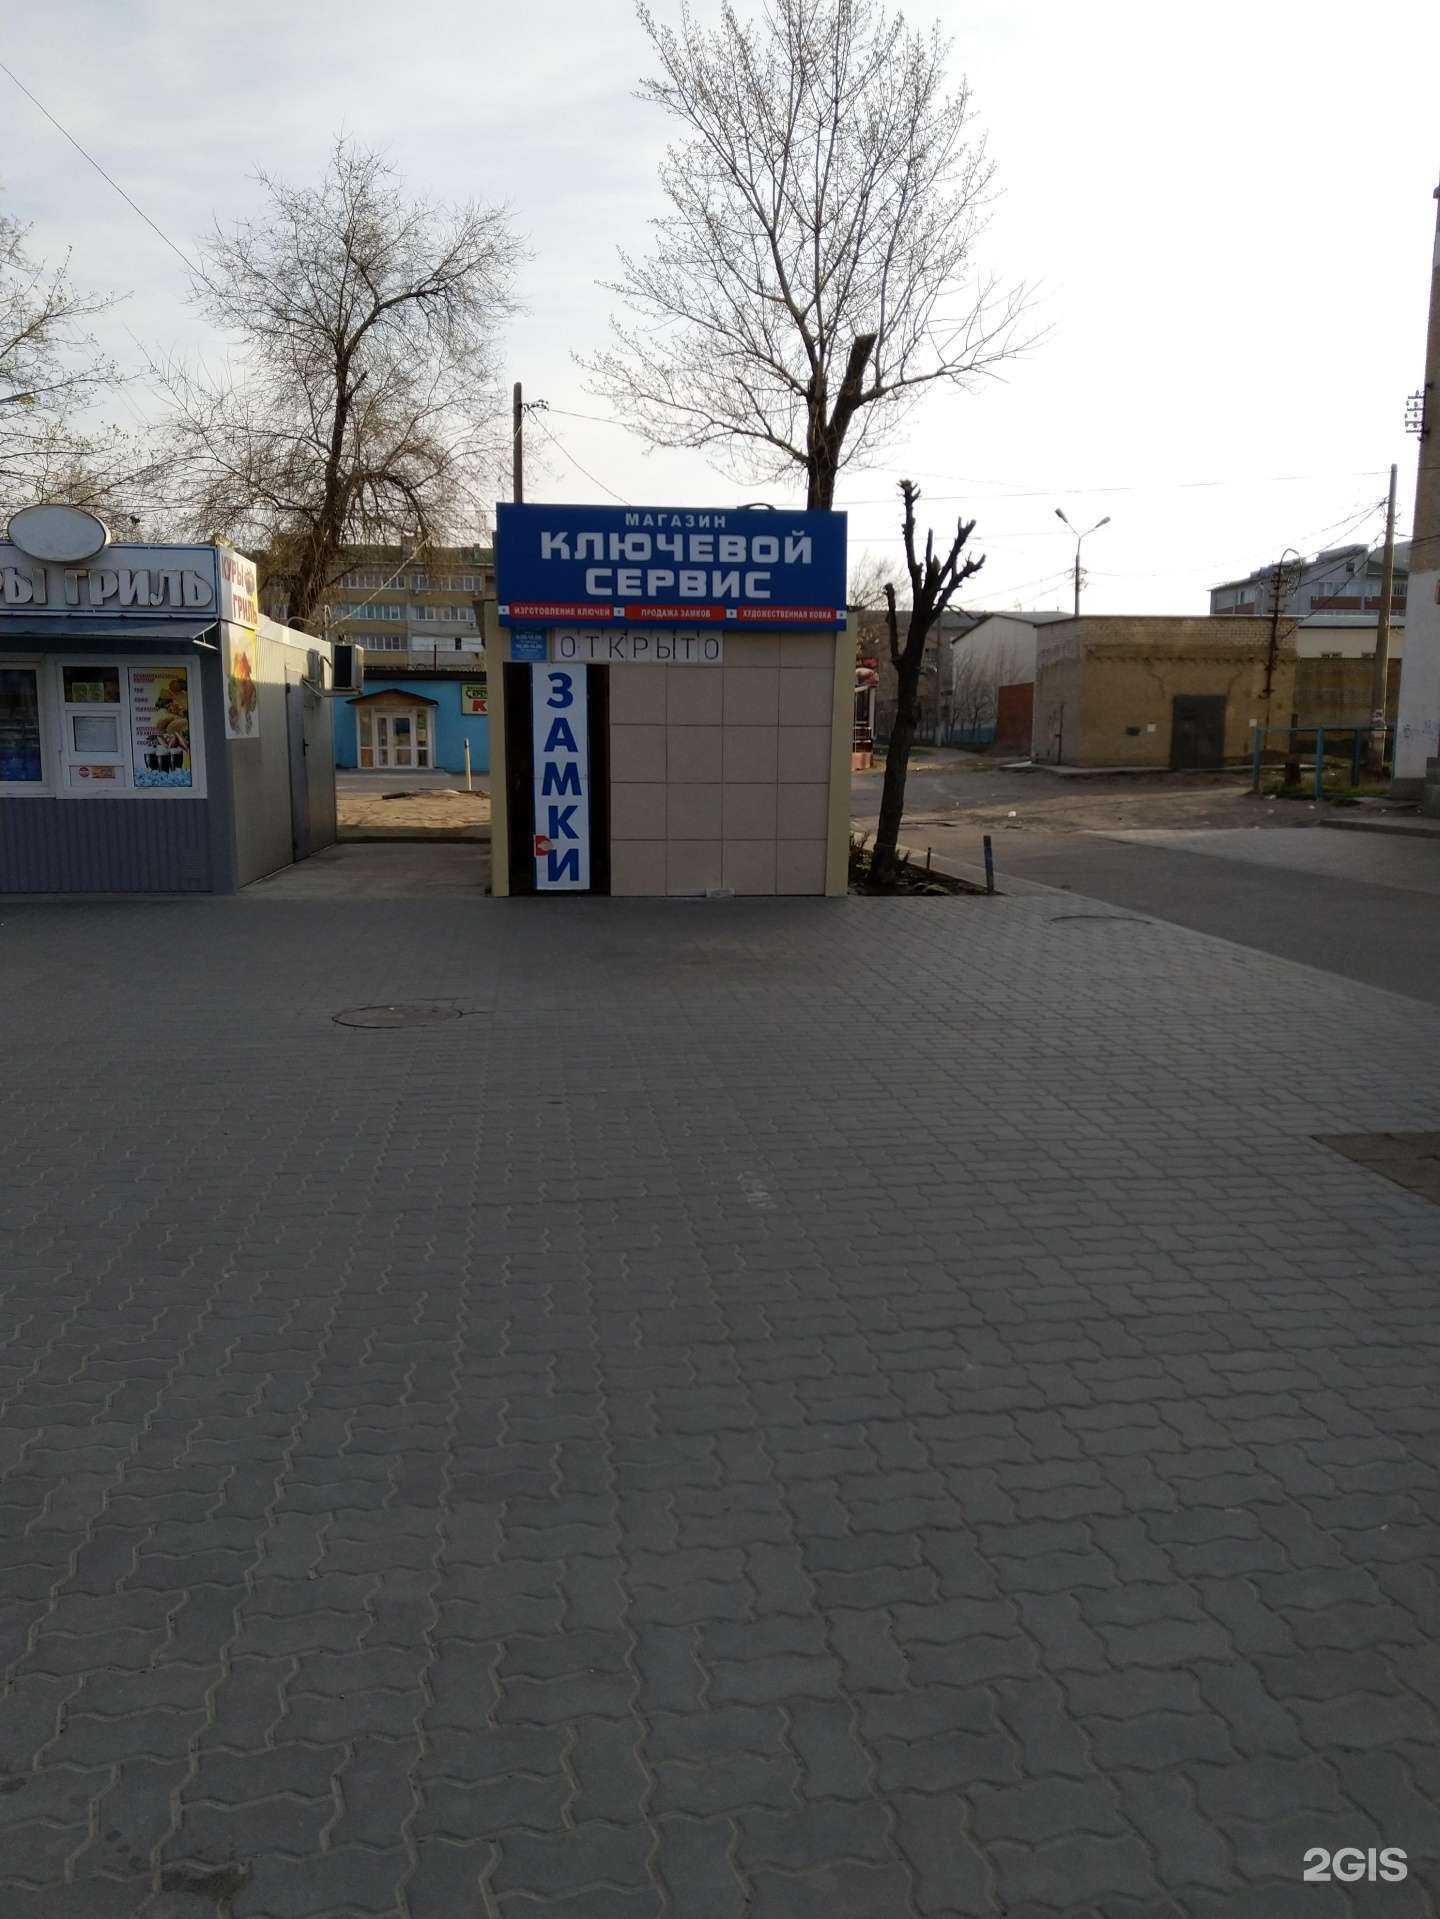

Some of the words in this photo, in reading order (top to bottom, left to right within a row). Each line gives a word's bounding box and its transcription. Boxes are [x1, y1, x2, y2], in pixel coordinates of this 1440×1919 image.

[625, 512, 727, 529] МАГАЗИН
[540, 530, 813, 565] КЛЮЧЕВОЙ
[64, 567, 214, 608] ГРИЛЬ
[585, 568, 771, 599] СЕРВИС
[514, 606, 575, 616] ИЗГОТОВЛЕНИЕ
[577, 607, 611, 617] КЛЮЧЕЙ
[641, 608, 678, 618] ПРОДАЖА
[680, 608, 711, 618] ЗАМКОВ
[743, 609, 808, 619] ХУДОЖЕСТВЕННАЯ
[809, 609, 832, 619] КОВКА
[560, 634, 720, 660] ОТКРЫТО
[541, 671, 583, 883] ЗАМКИ
